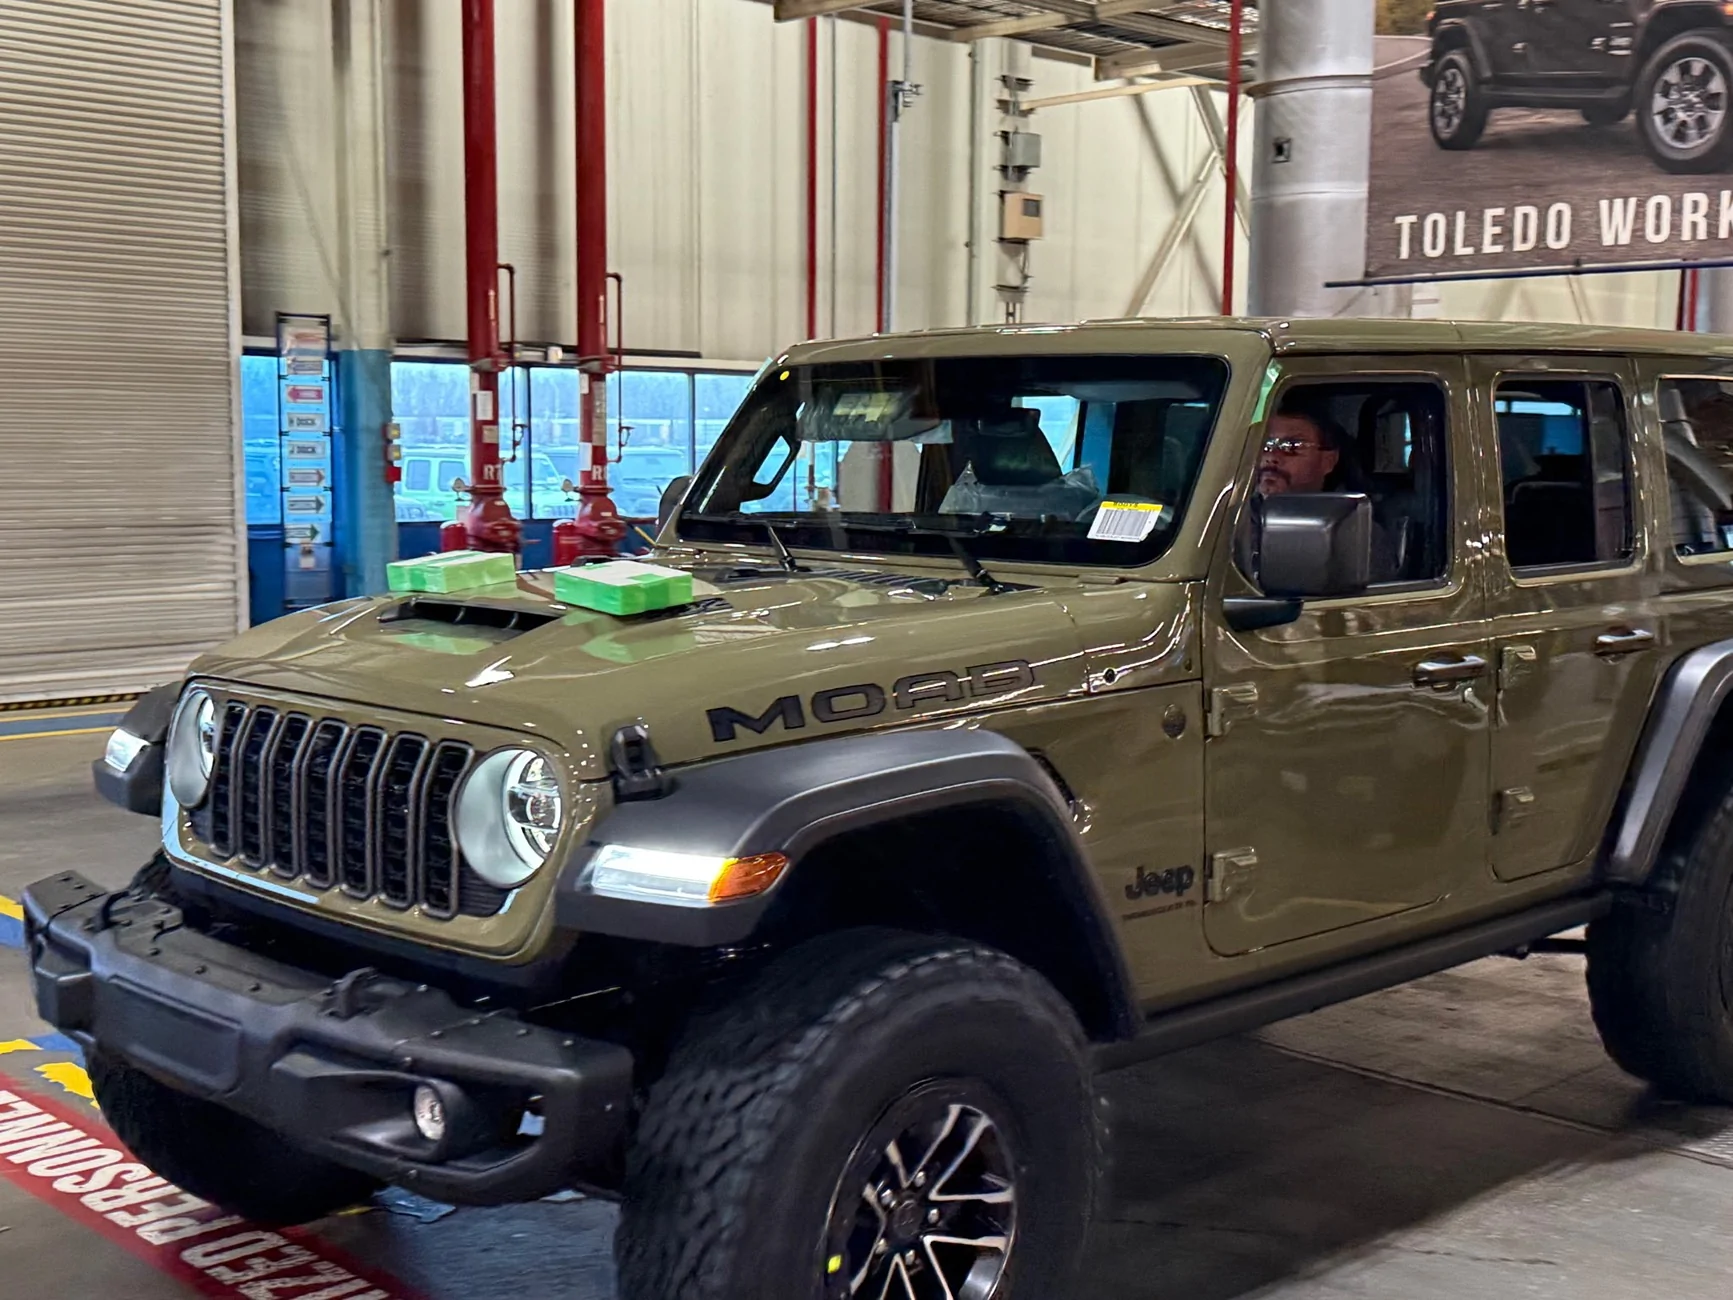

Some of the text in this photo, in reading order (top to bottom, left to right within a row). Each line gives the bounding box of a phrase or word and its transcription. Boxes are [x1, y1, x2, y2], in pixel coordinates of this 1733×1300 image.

[1394, 202, 1573, 260] TOLEDO
[705, 659, 1036, 742] MOAB
[1124, 865, 1194, 900] Jeep
